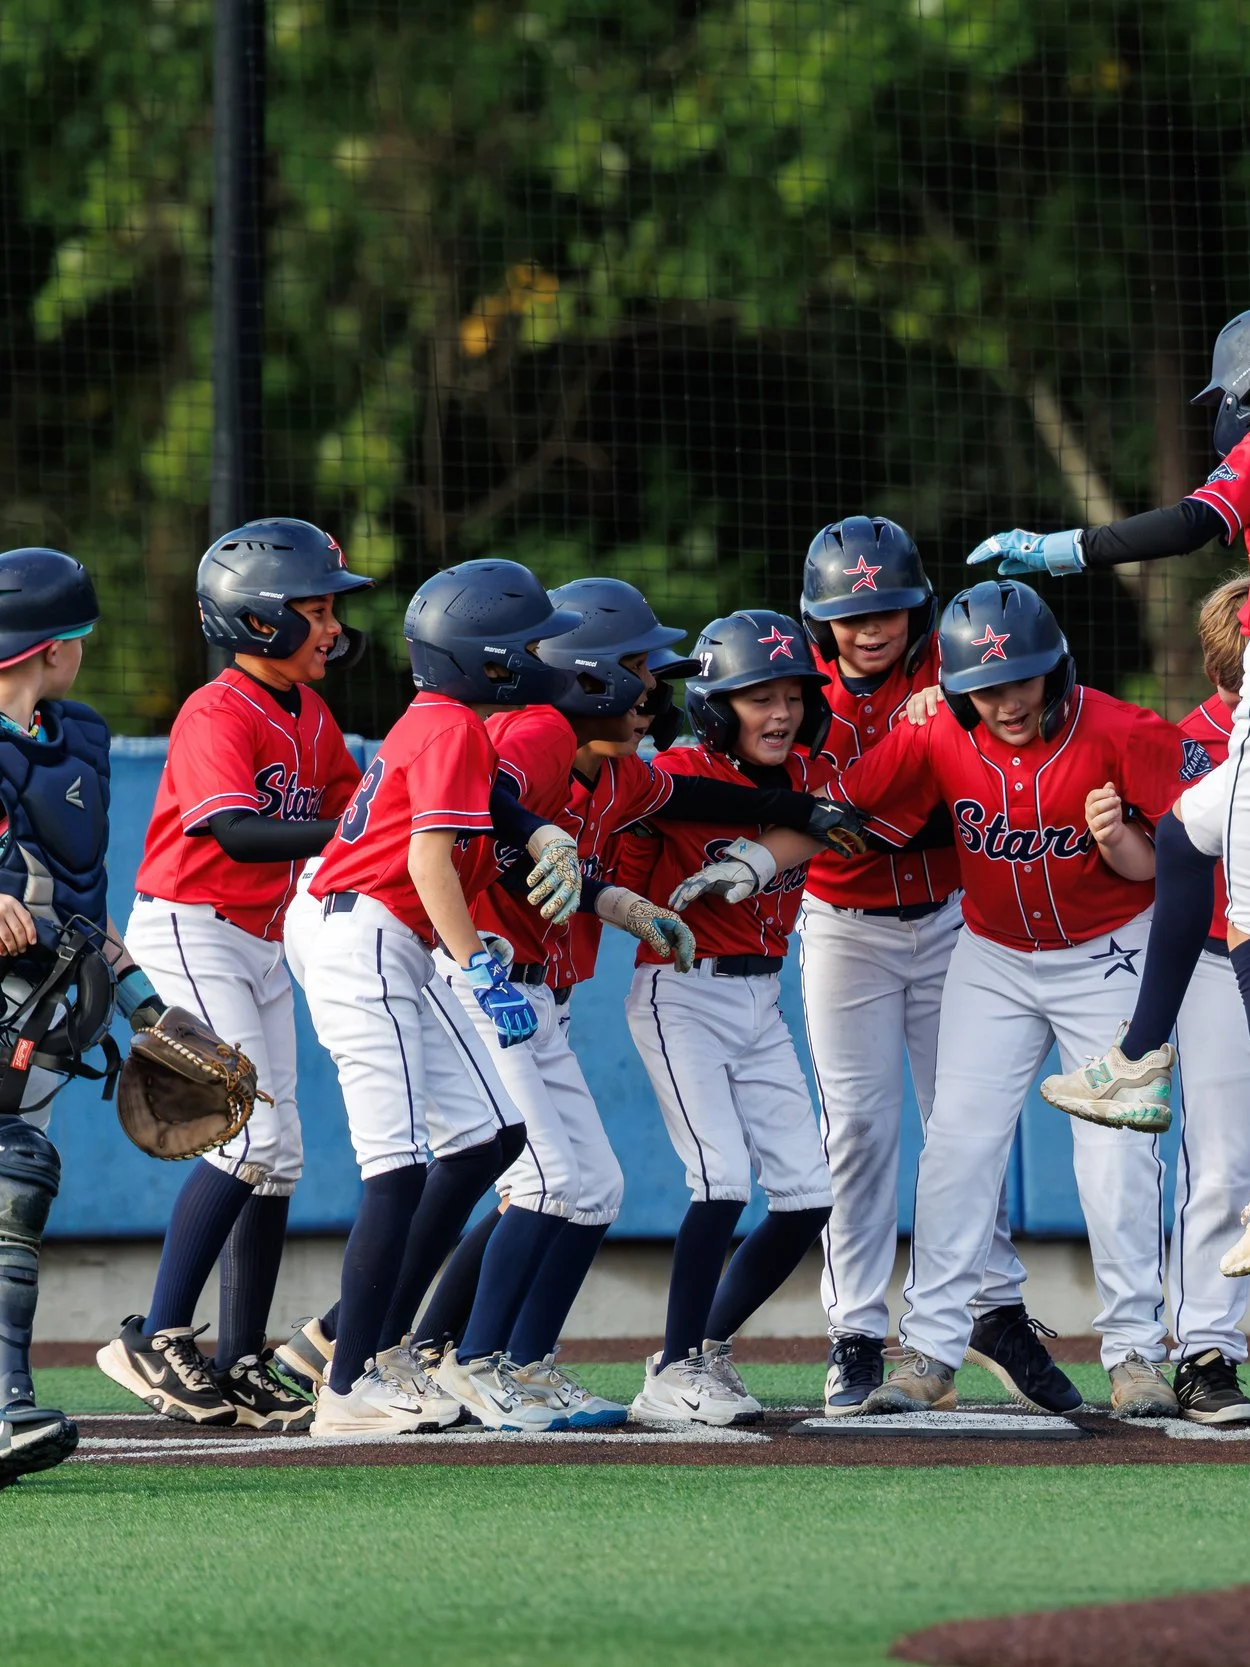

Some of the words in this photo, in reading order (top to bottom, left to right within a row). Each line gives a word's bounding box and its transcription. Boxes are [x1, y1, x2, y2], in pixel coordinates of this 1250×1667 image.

[259, 591, 285, 600] marucci
[483, 645, 507, 655] marucci
[575, 658, 598, 668] marucci
[1181, 743, 1206, 780] FRANCHI
